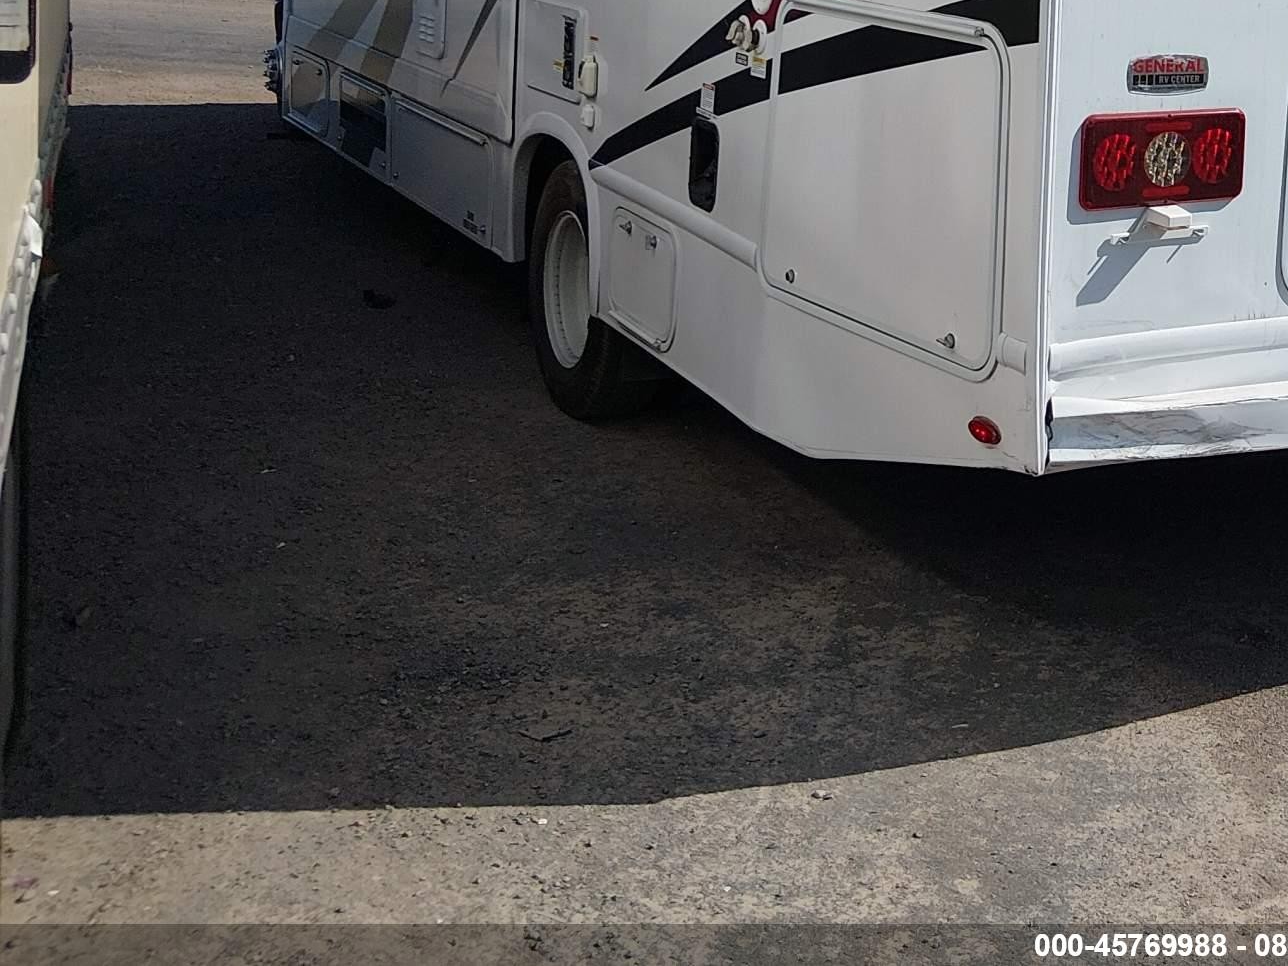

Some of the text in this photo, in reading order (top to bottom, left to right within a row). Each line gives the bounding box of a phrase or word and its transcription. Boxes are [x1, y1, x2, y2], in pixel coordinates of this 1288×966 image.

[1132, 57, 1206, 74] GENERAL
[1158, 74, 1201, 84] RV CENTER
